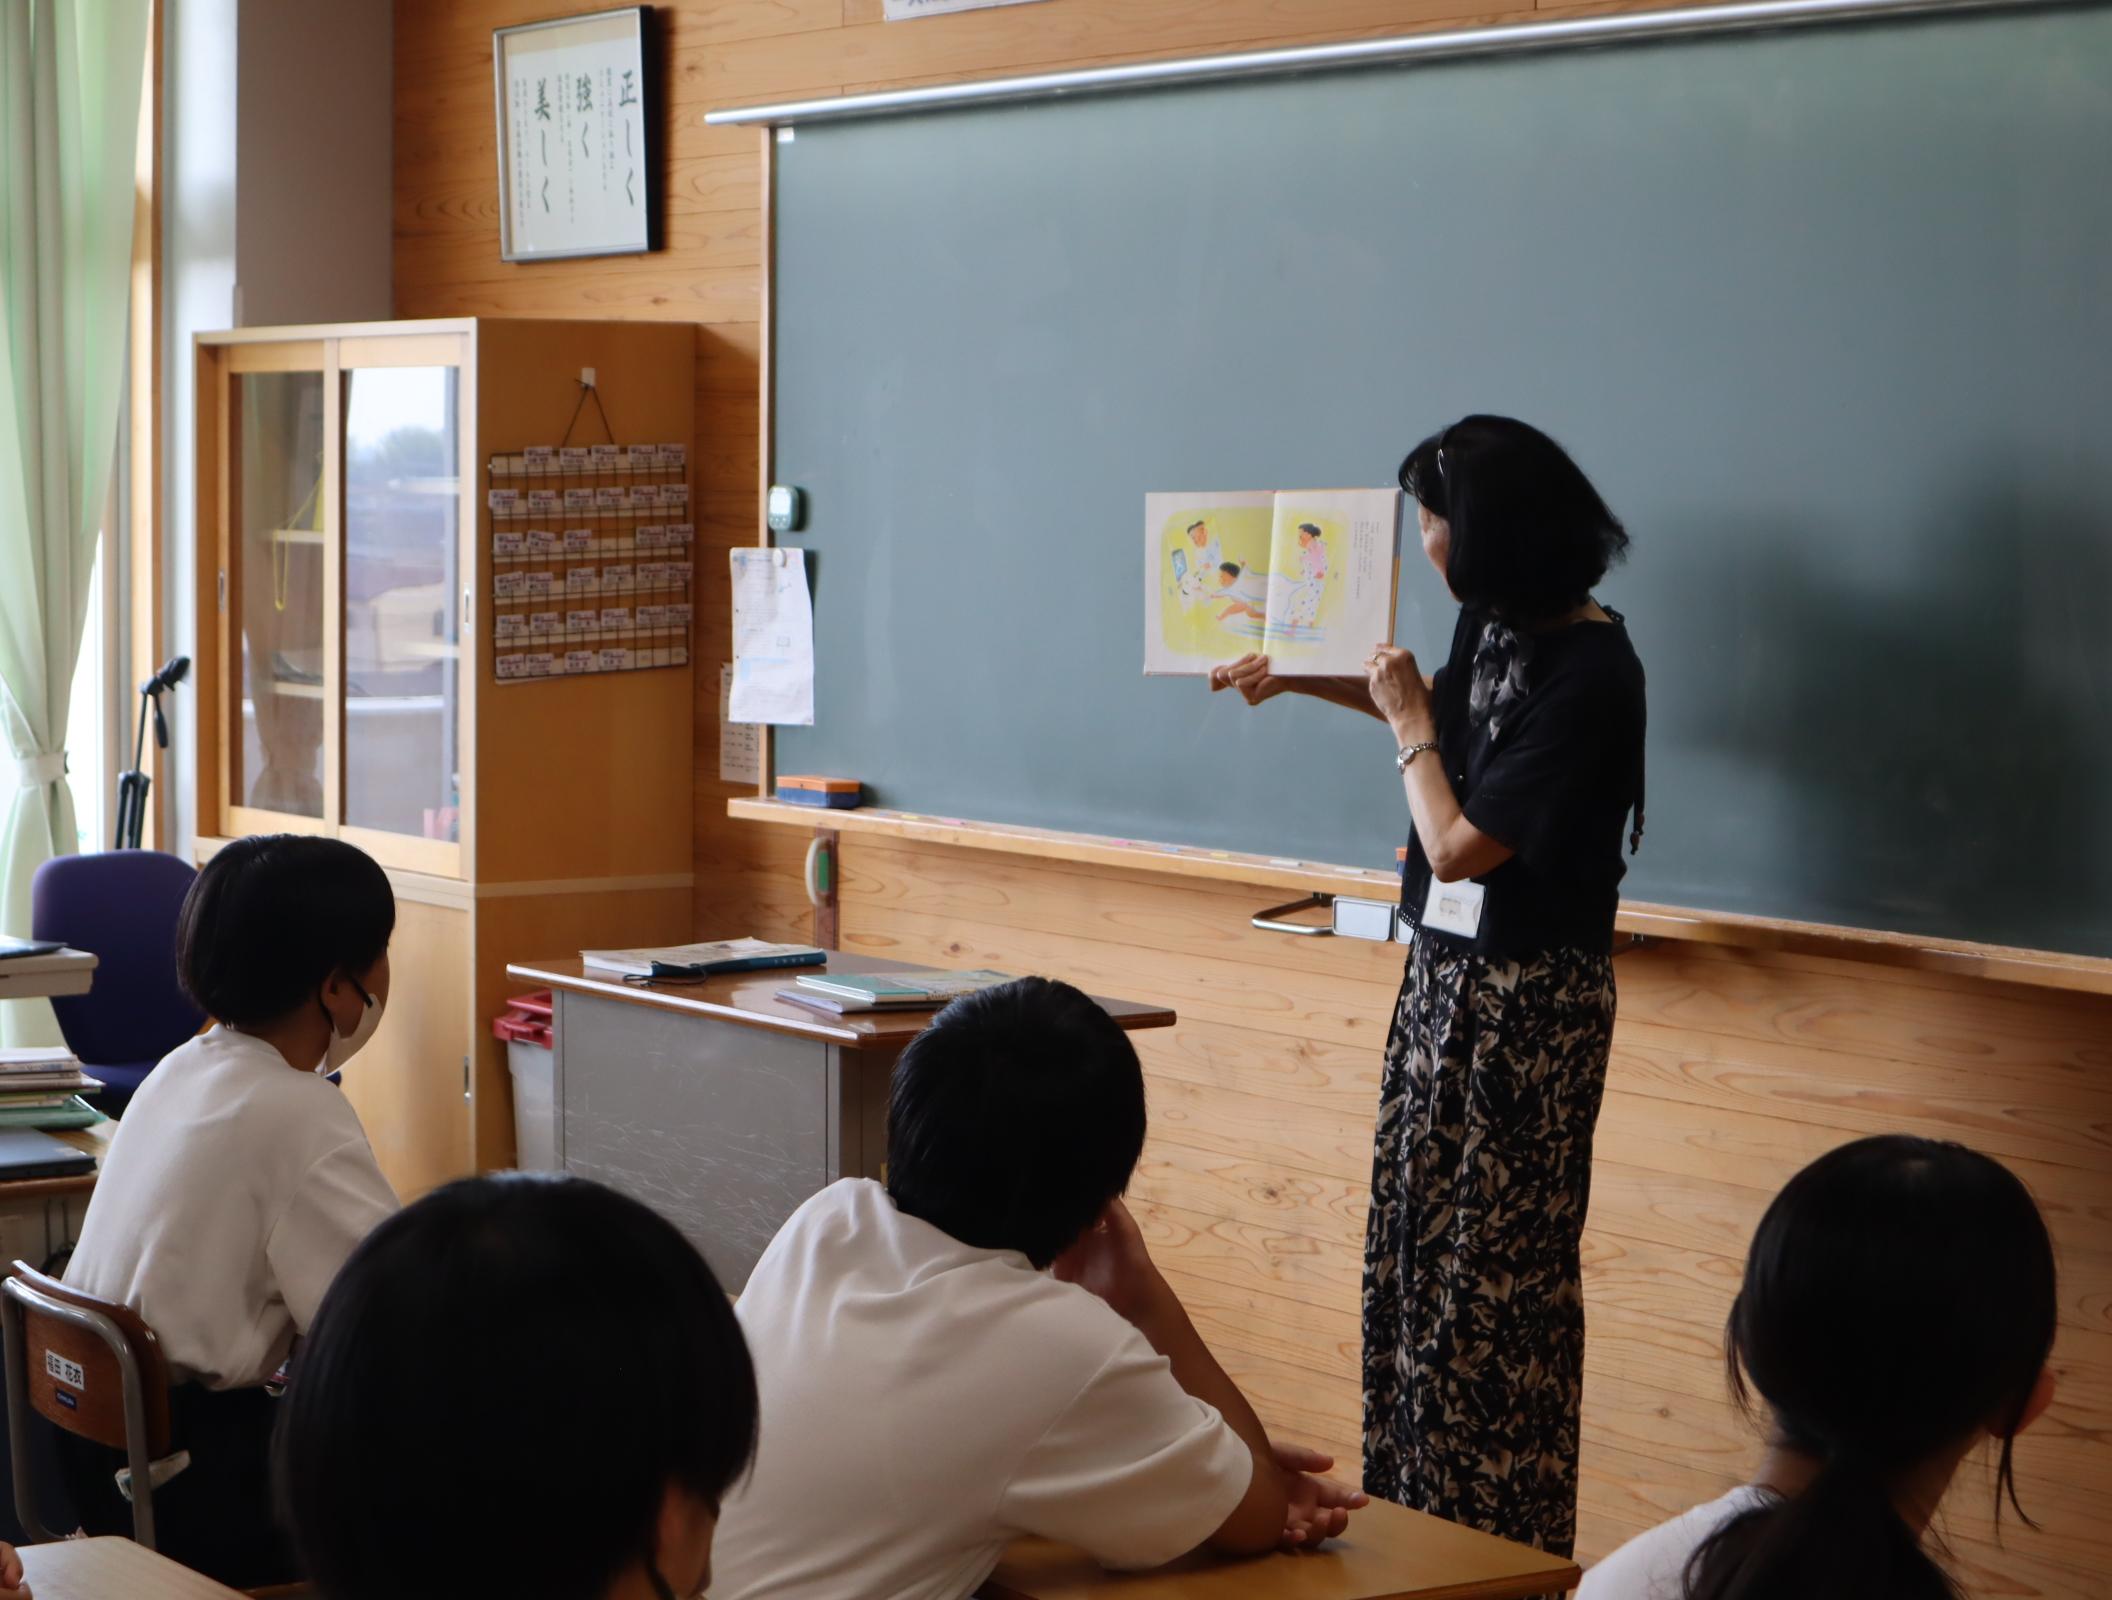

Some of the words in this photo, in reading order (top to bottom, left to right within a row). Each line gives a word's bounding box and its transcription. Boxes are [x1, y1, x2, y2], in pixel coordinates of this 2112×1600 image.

[534, 77, 551, 213] 美しく
[576, 73, 593, 159] 強く
[619, 70, 637, 206] 正しく
